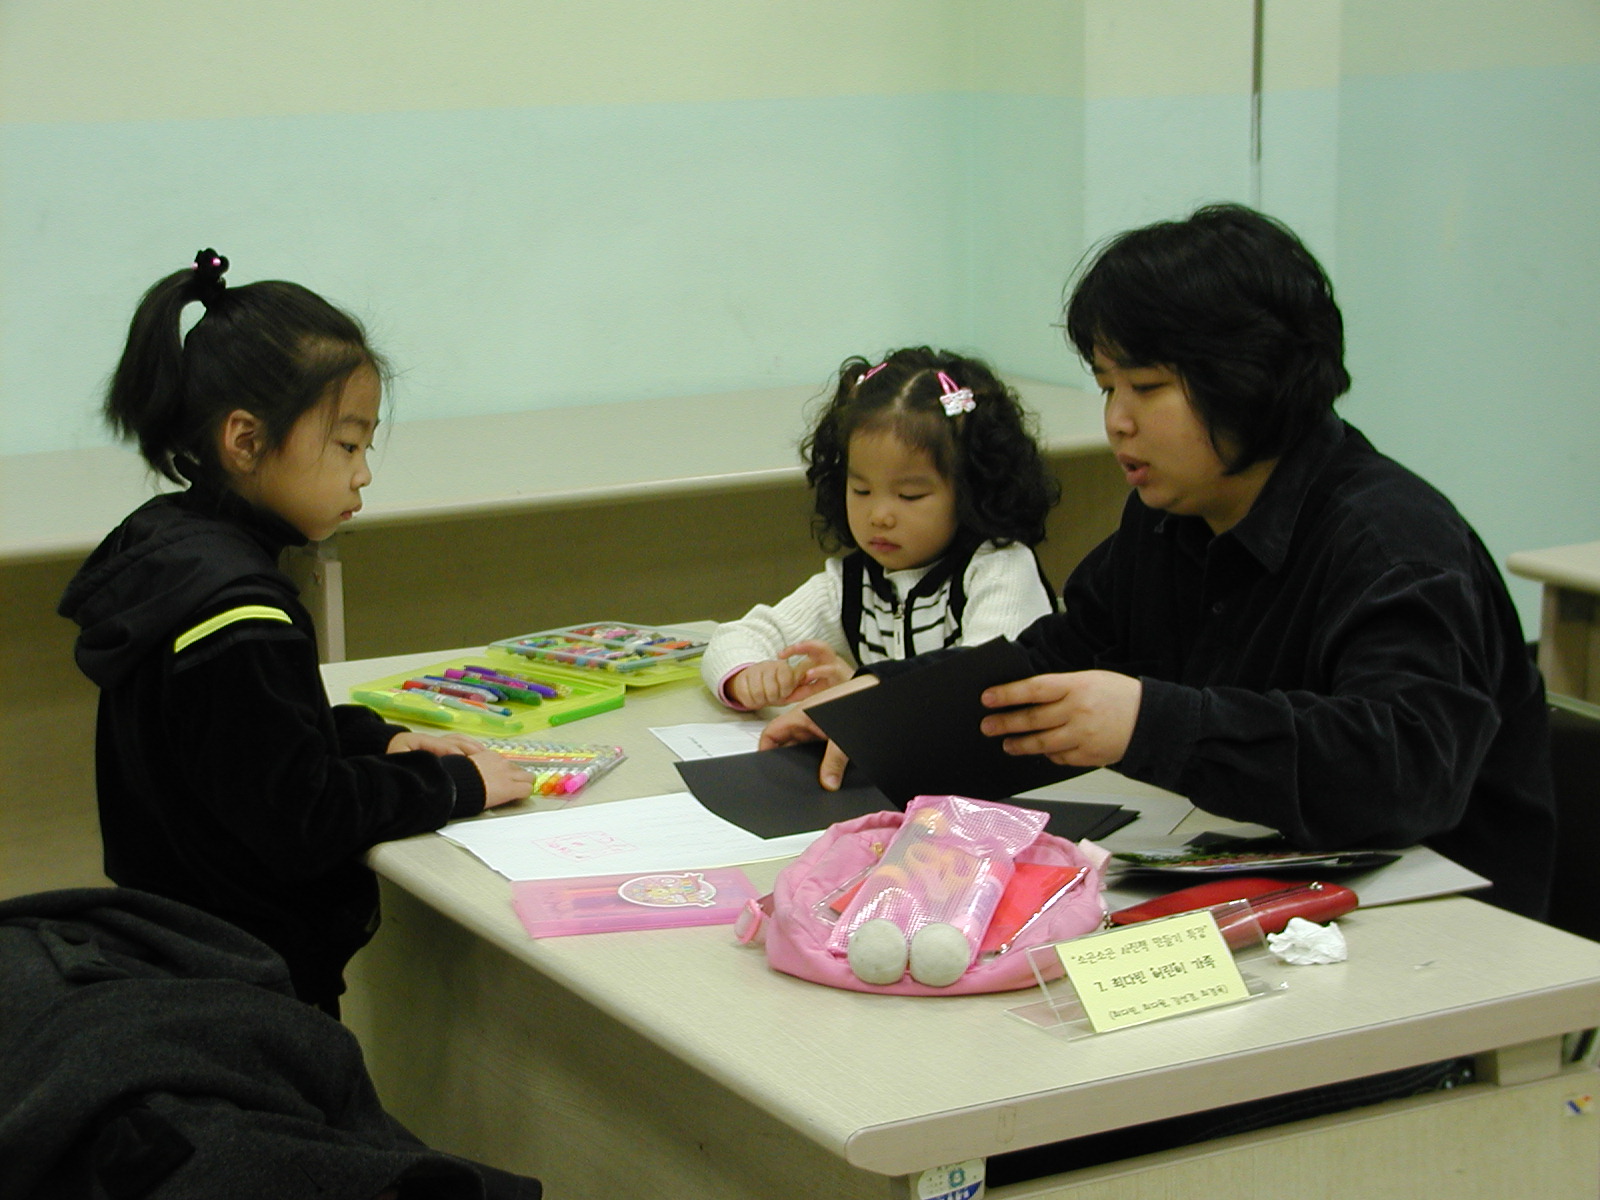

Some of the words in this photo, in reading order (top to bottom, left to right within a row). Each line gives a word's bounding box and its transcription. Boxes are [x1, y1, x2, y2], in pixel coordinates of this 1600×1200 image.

[1152, 933, 1183, 949] 만들기
[1150, 963, 1187, 980] 어린이
[1192, 955, 1216, 969] 가족
